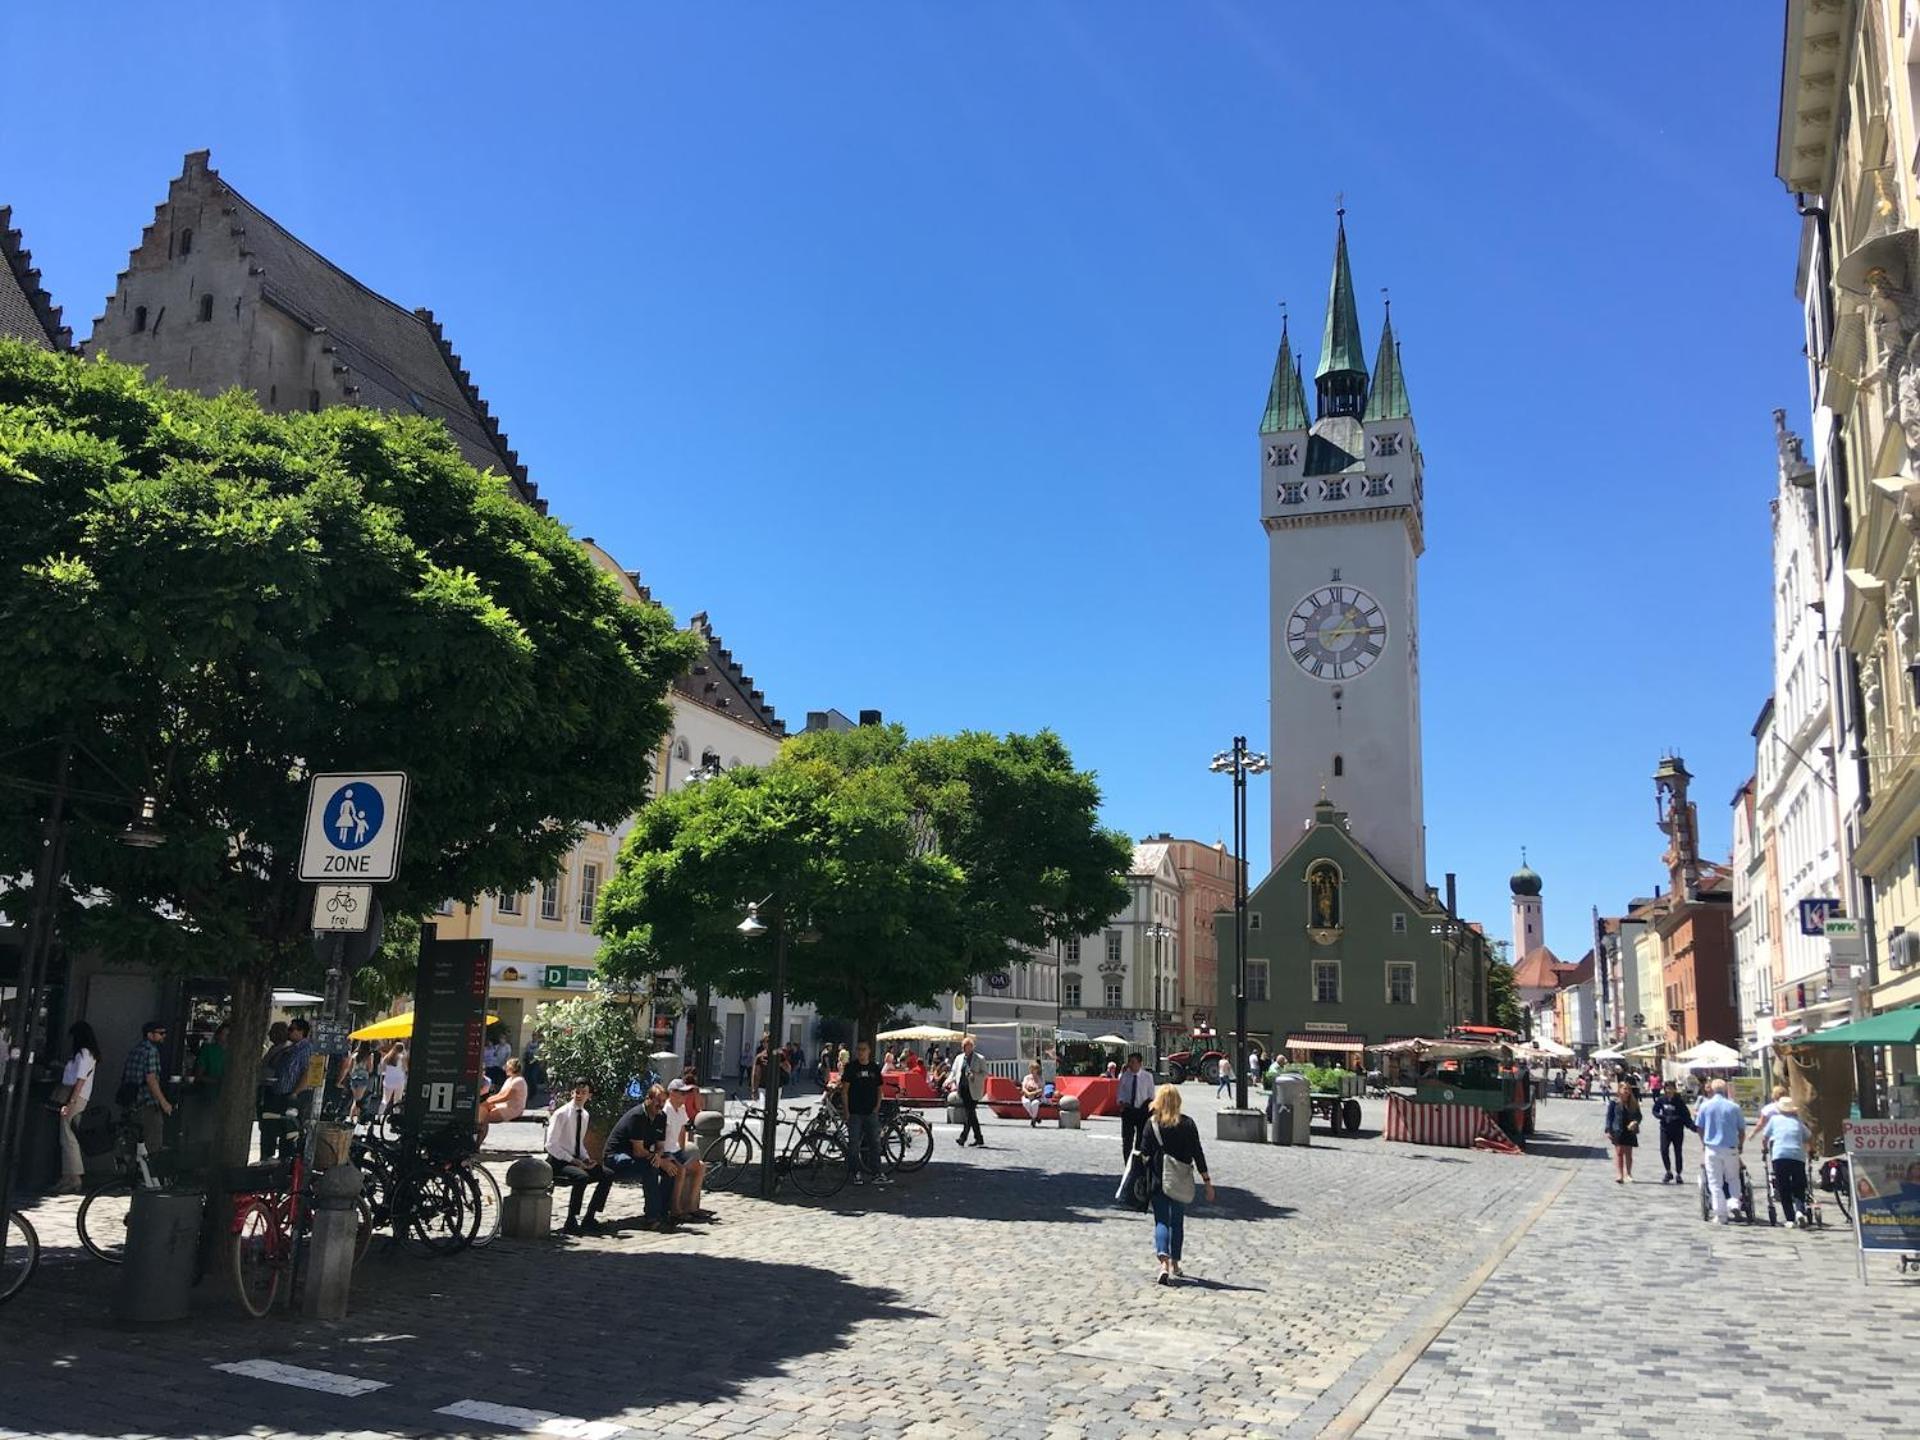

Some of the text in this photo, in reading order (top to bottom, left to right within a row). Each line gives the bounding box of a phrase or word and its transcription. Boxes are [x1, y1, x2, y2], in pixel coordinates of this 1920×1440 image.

[323, 855, 371, 873] ZONE
[330, 914, 349, 926] frei
[1826, 923, 1856, 932] WWK
[549, 969, 562, 984] D
[1855, 1136, 1915, 1150] Sofort
